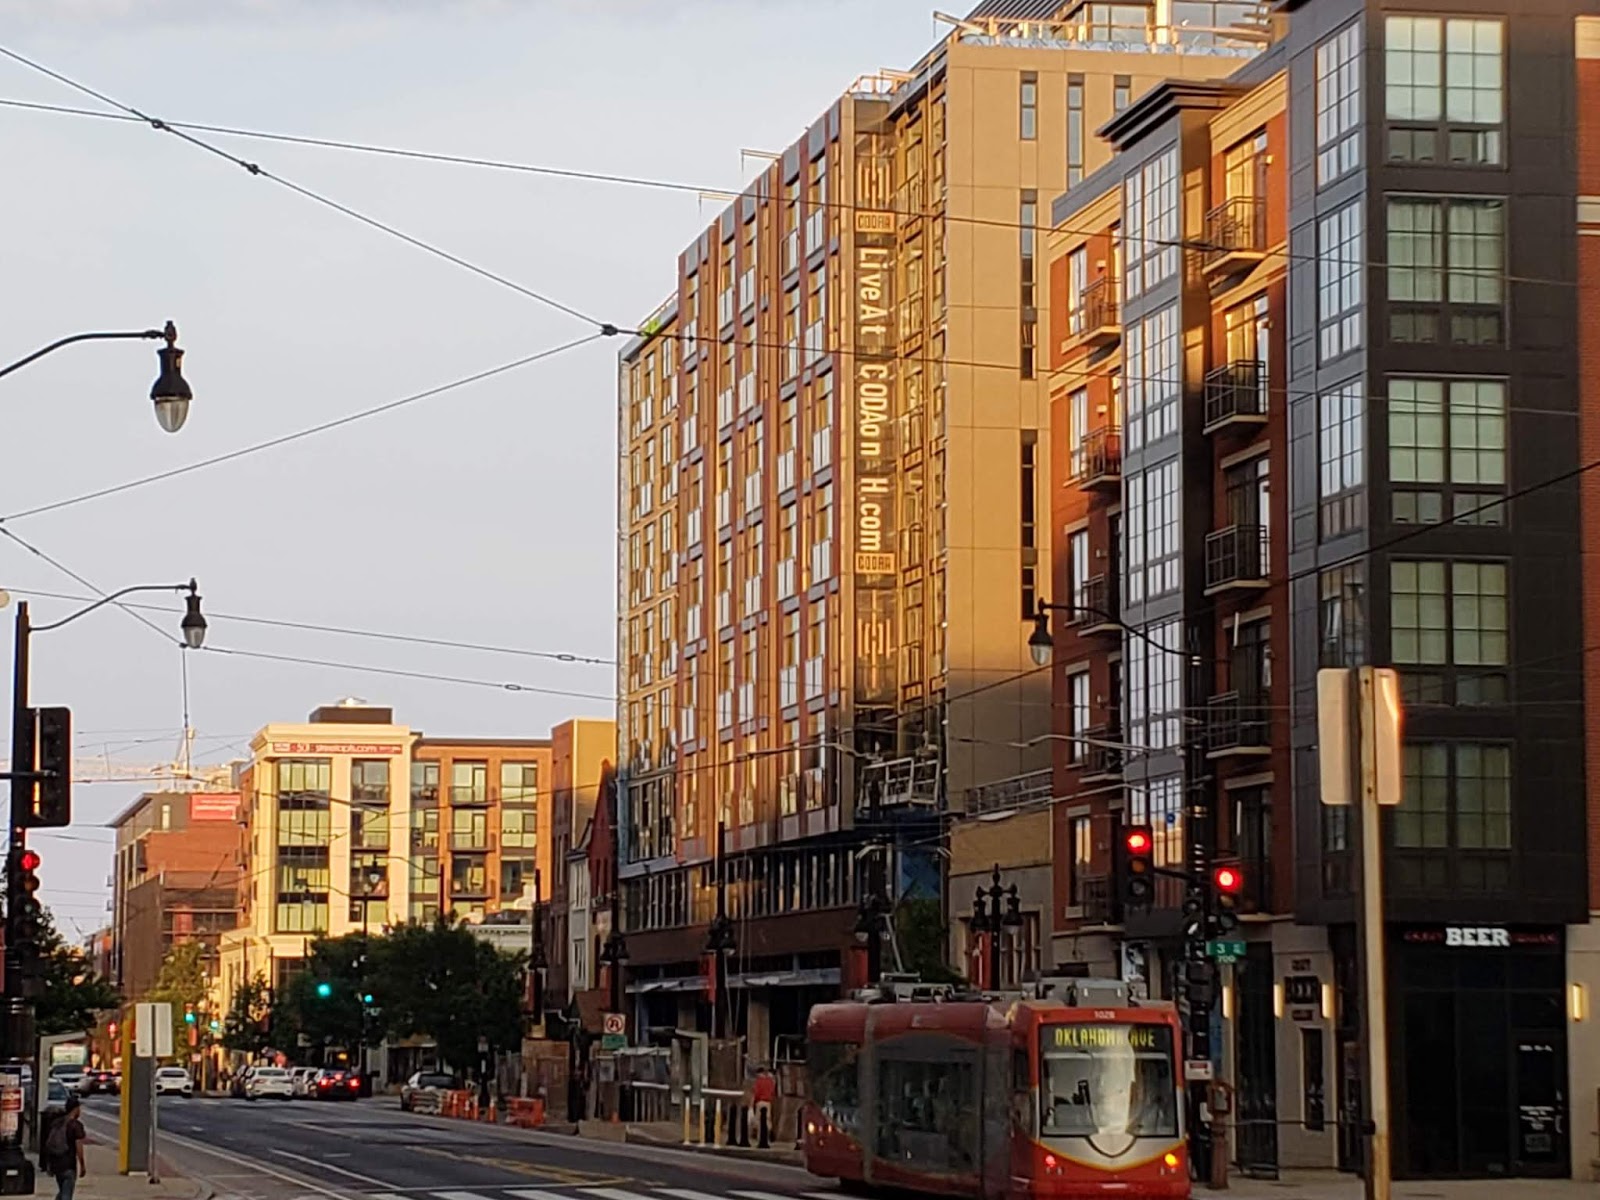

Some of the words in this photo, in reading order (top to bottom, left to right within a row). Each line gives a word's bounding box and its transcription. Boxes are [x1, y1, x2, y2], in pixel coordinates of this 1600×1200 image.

[1445, 927, 1510, 947] BEER
[1055, 1028, 1124, 1047] OKLAHOMA
[1130, 1028, 1155, 1047] AVE
